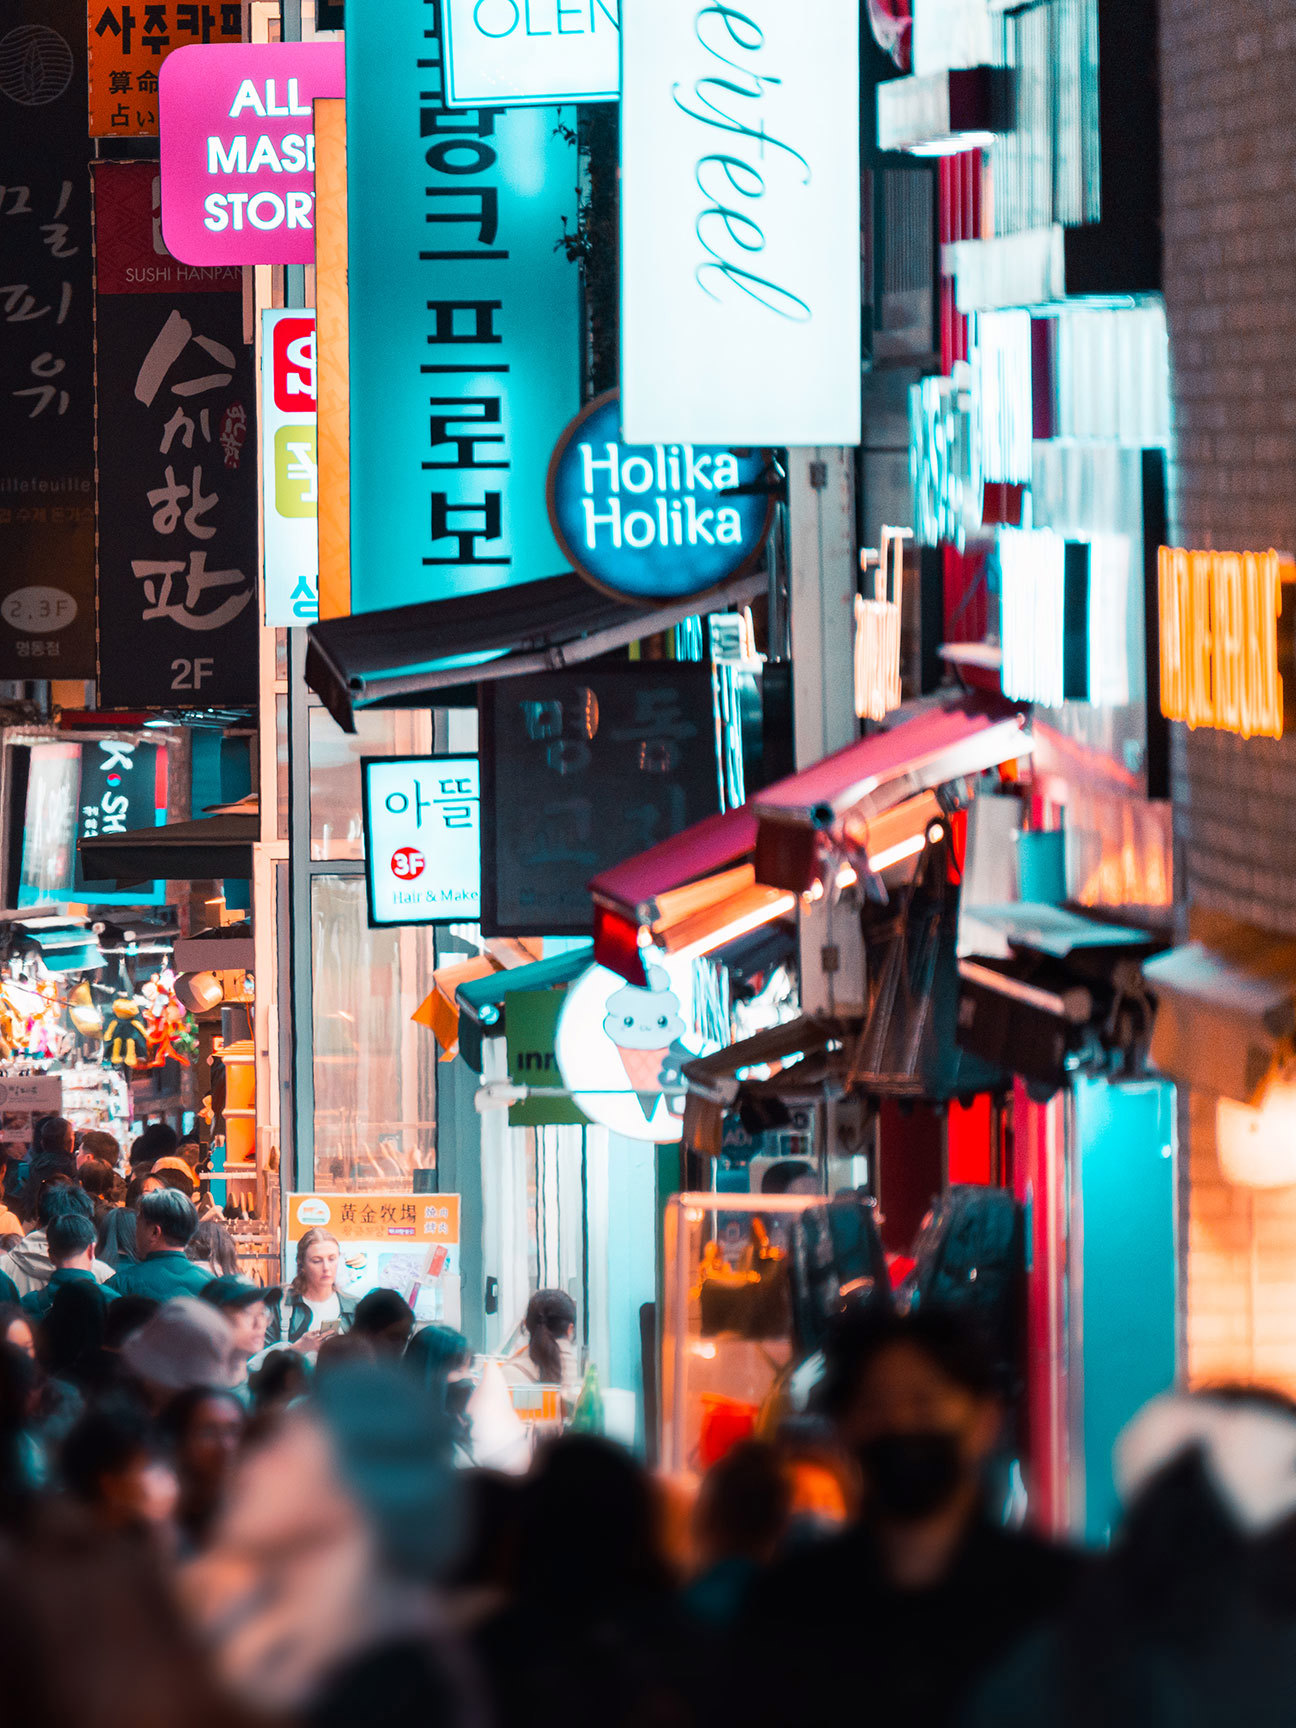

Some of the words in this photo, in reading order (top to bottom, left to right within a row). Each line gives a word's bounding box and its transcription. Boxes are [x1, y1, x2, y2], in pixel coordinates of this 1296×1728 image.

[228, 78, 312, 118] ALL
[203, 190, 316, 232] STOR
[125, 267, 171, 283] SUSHI
[420, 299, 512, 566] 프로보
[578, 443, 741, 494] Holika
[580, 498, 744, 550] Holika
[170, 658, 215, 690] 2F
[393, 852, 424, 876] 3F
